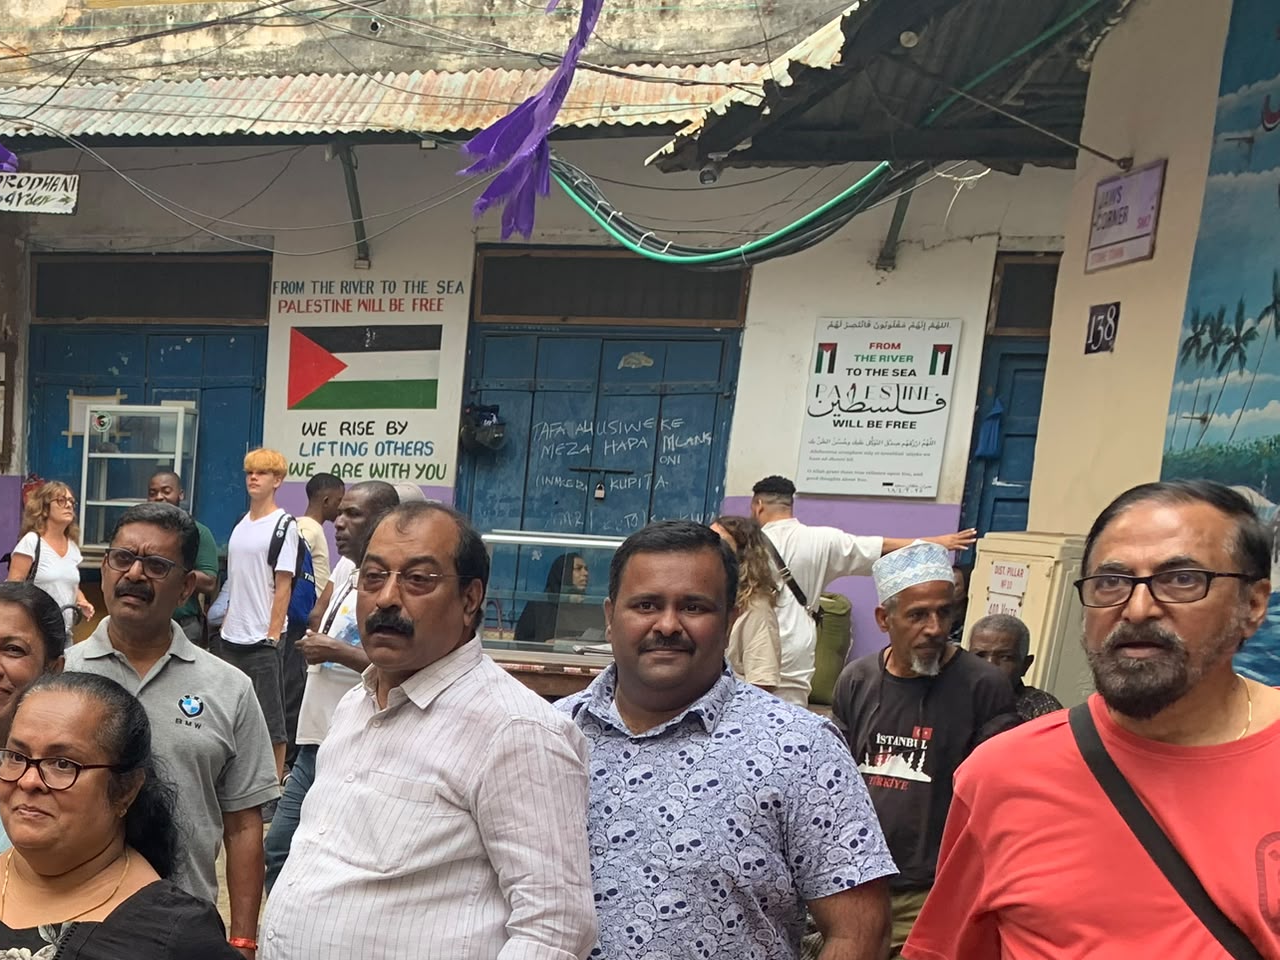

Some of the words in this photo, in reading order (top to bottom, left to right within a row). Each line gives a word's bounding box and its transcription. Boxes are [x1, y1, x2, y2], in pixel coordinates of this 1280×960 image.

[272, 280, 305, 294] FROM
[311, 280, 336, 294] THE
[340, 280, 374, 294] RIVER
[380, 280, 397, 294] TO
[403, 280, 428, 294] THE
[436, 280, 465, 294] SEA
[278, 299, 353, 313] PALESTINE
[357, 299, 385, 312] WILL
[389, 298, 405, 312] BE
[412, 298, 445, 311] FREE
[1088, 305, 1116, 349] 138
[869, 342, 901, 350] FROM
[854, 354, 876, 363] THE
[879, 354, 914, 363] RIVER
[845, 368, 862, 377] TO
[864, 368, 889, 377] THE
[891, 368, 917, 377] SEA
[815, 383, 936, 401] PALESTINE
[301, 422, 327, 436] WE
[339, 421, 375, 436] RISE
[385, 420, 408, 435] BY
[832, 419, 864, 428] WILL
[867, 420, 883, 429] BE
[885, 420, 917, 429] FREE
[299, 441, 368, 457] LIFTING
[375, 440, 434, 457] OTHERS
[540, 441, 591, 459] MEZA
[604, 437, 648, 456] HAPA
[288, 462, 316, 477] WE
[330, 462, 364, 478] ARE
[369, 462, 410, 479] WITH
[415, 463, 447, 480] YOU
[1006, 567, 1025, 578] PILLAR
[175, 717, 203, 730] BMW
